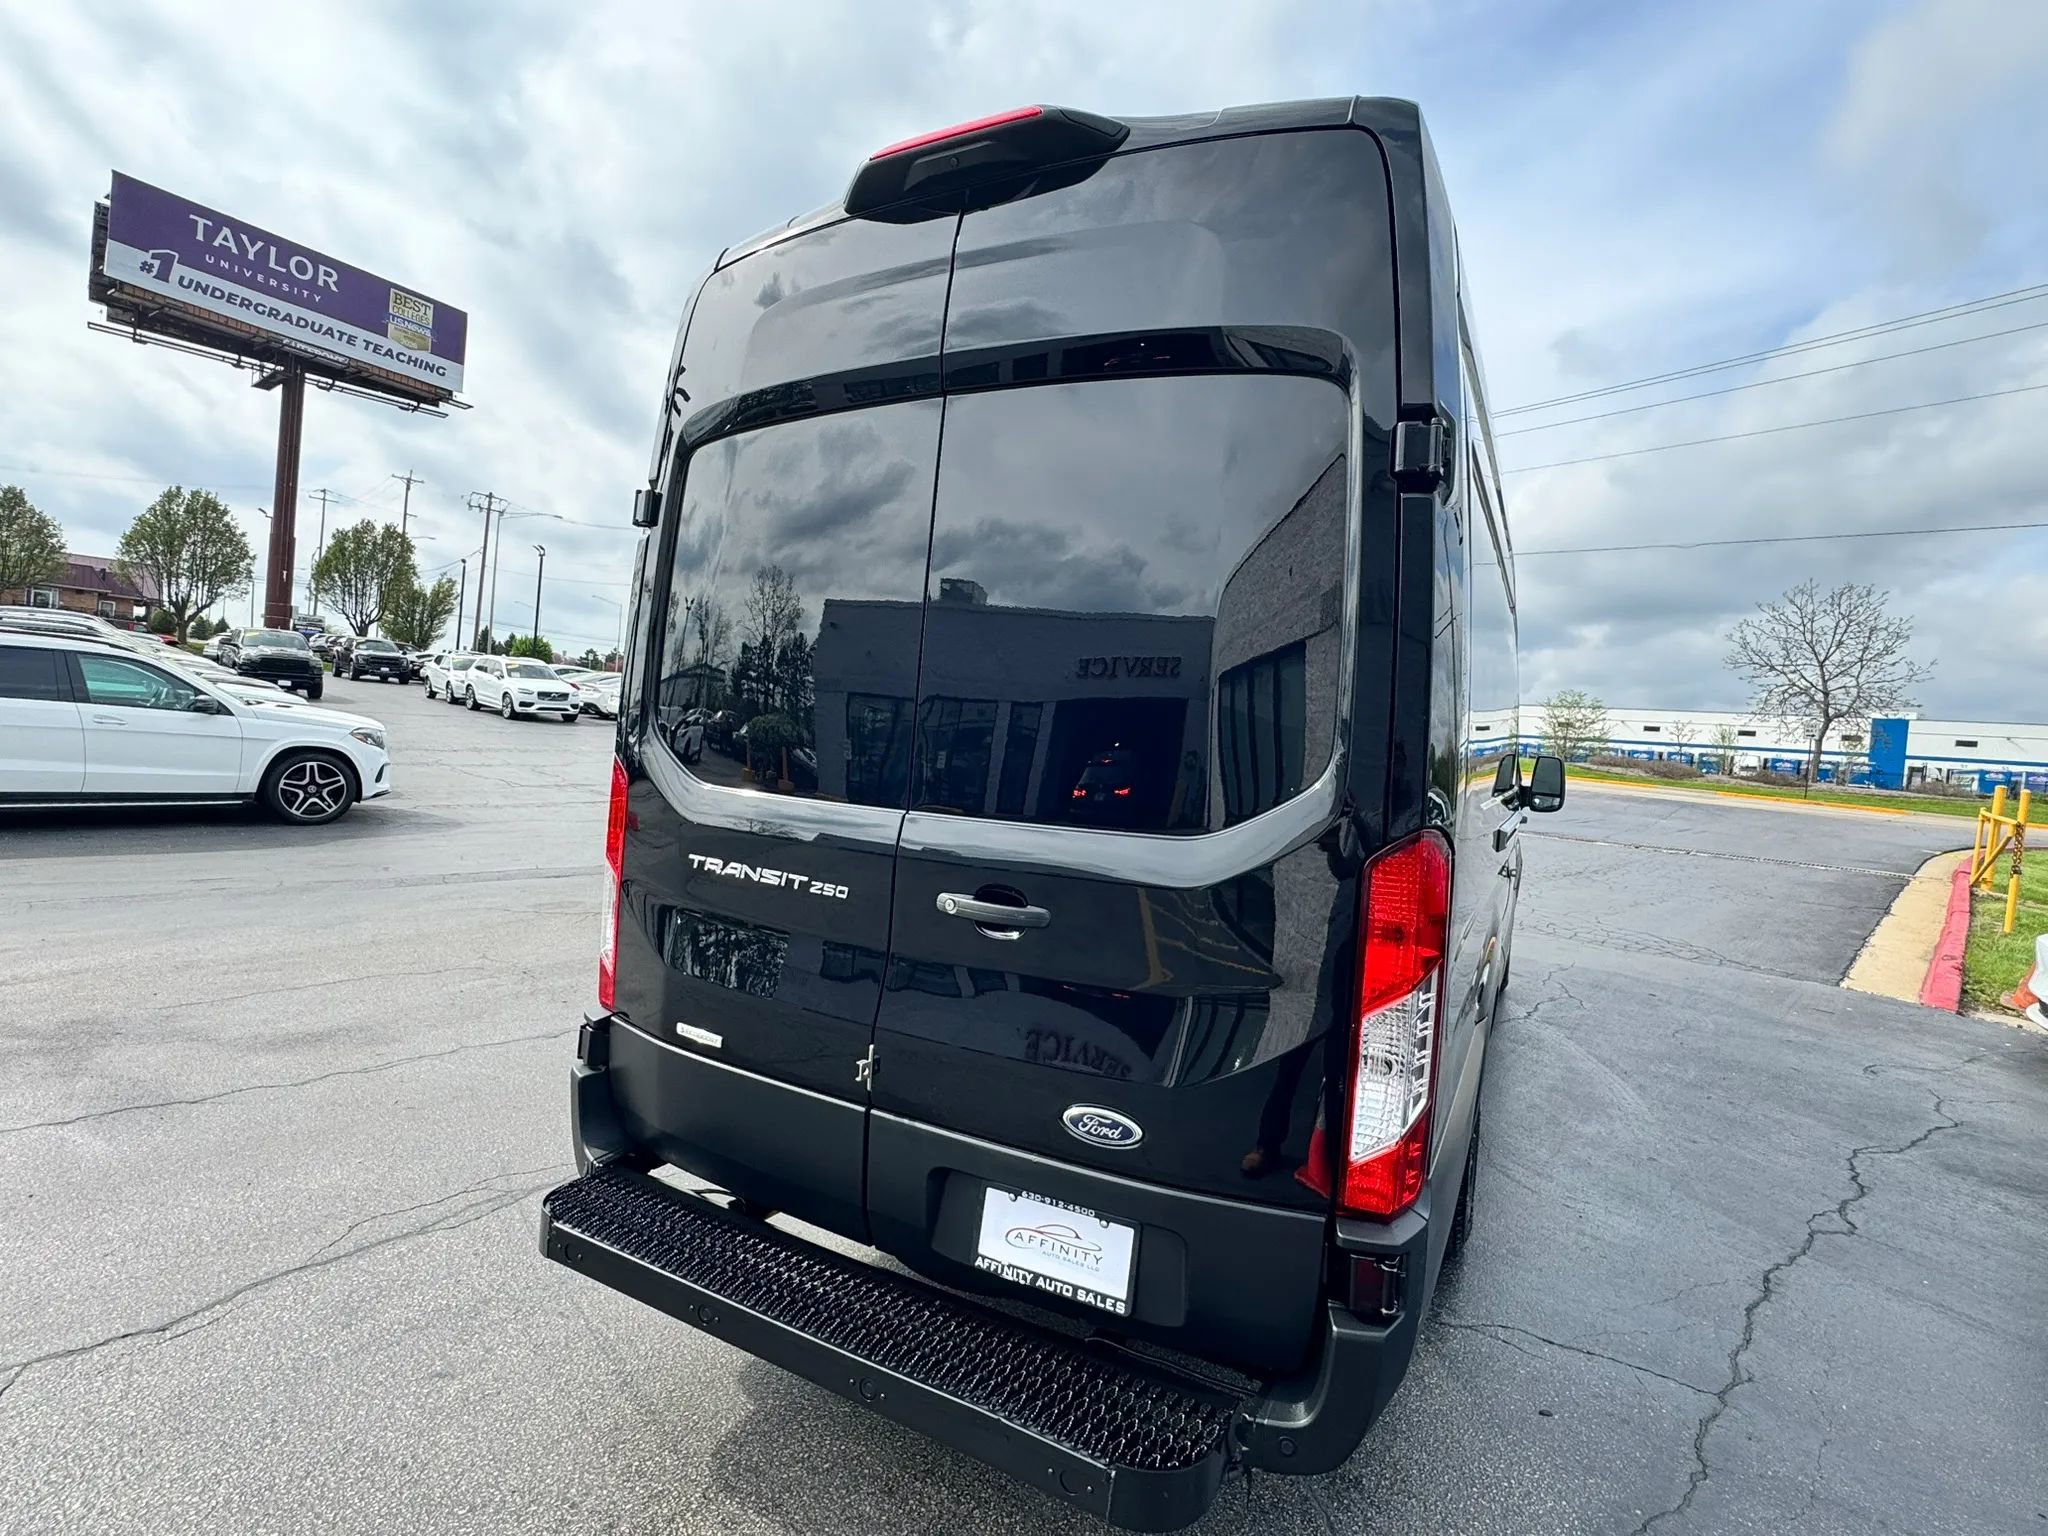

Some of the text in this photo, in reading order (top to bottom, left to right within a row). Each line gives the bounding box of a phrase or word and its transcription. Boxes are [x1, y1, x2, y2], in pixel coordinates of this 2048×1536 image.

[189, 214, 339, 292] TAYLOR
[205, 254, 321, 303] UNIVERSITY
[139, 251, 177, 284] #1
[178, 275, 358, 347] UNDERGRADUATE
[363, 339, 447, 377] TEACHING
[392, 305, 430, 326] COLLEGES
[393, 291, 431, 316] BEST
[688, 853, 849, 900] TRANSIT 250
[1078, 1114, 1123, 1140] Ford
[1021, 1190, 1096, 1218] 630-912-4500
[1014, 1231, 1104, 1265] AFFINITY
[1041, 1250, 1061, 1261] AUTO
[974, 1255, 1126, 1315] AFFINITY AUTO SALES
